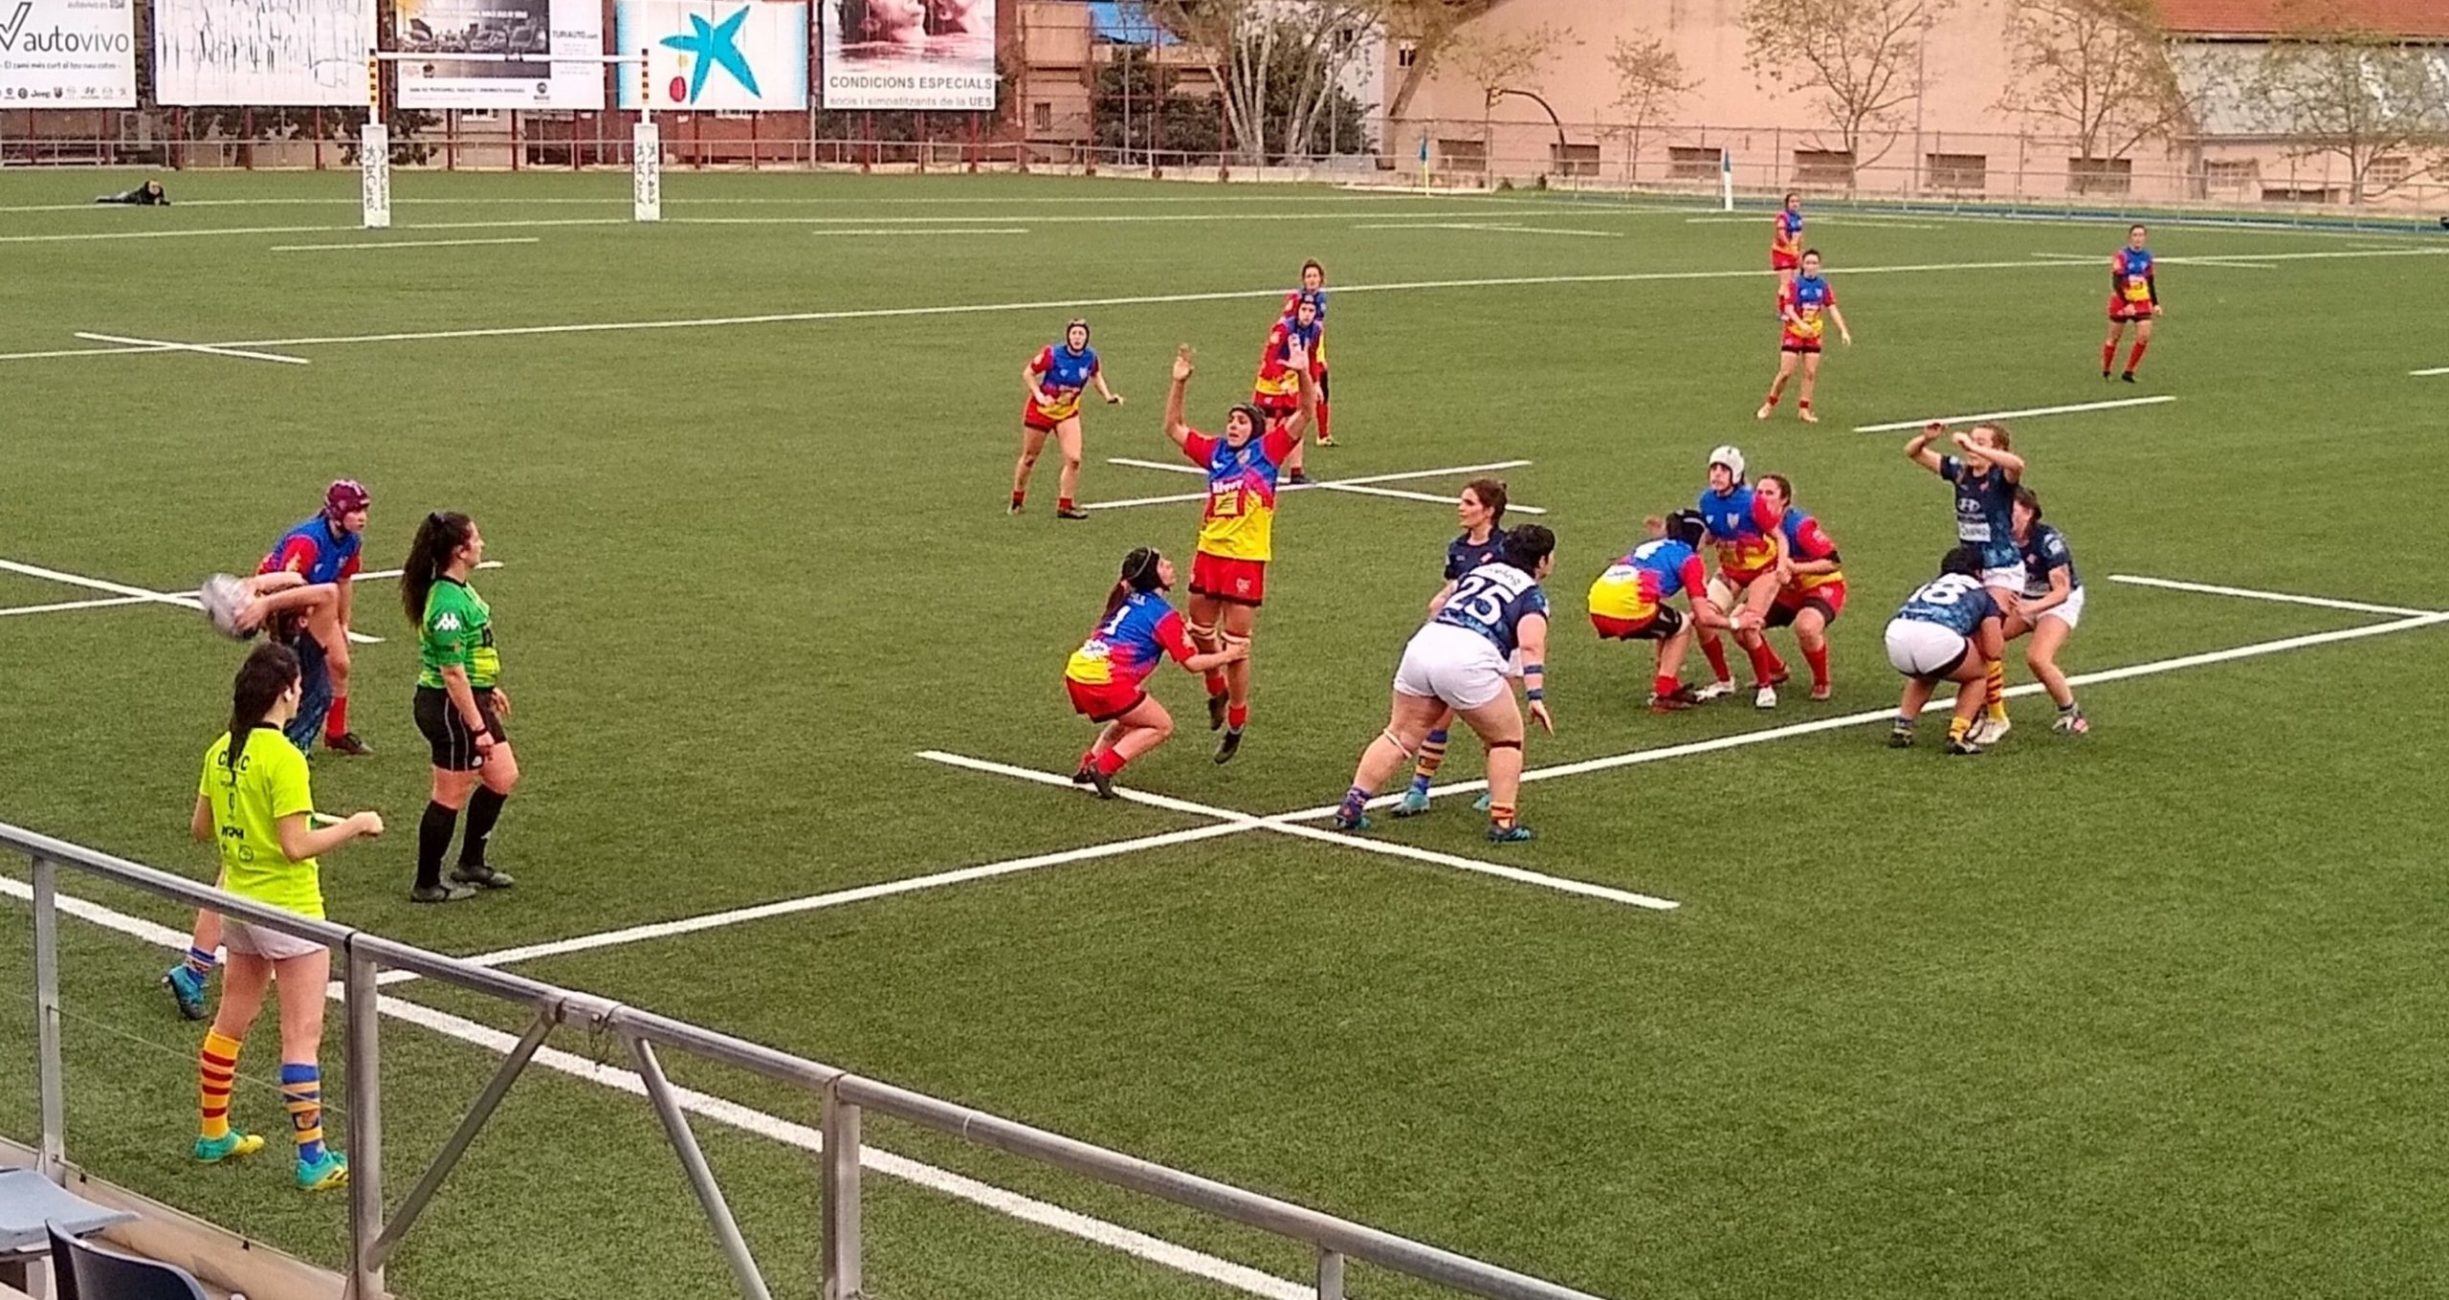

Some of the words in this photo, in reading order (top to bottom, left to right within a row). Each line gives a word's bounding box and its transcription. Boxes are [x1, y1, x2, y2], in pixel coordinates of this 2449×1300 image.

[23, 25, 129, 52] autovivo
[829, 76, 915, 89] CONDICIONS
[919, 77, 993, 90] ESPECIALS
[969, 96, 992, 107] UES
[1443, 575, 1515, 625] 25
